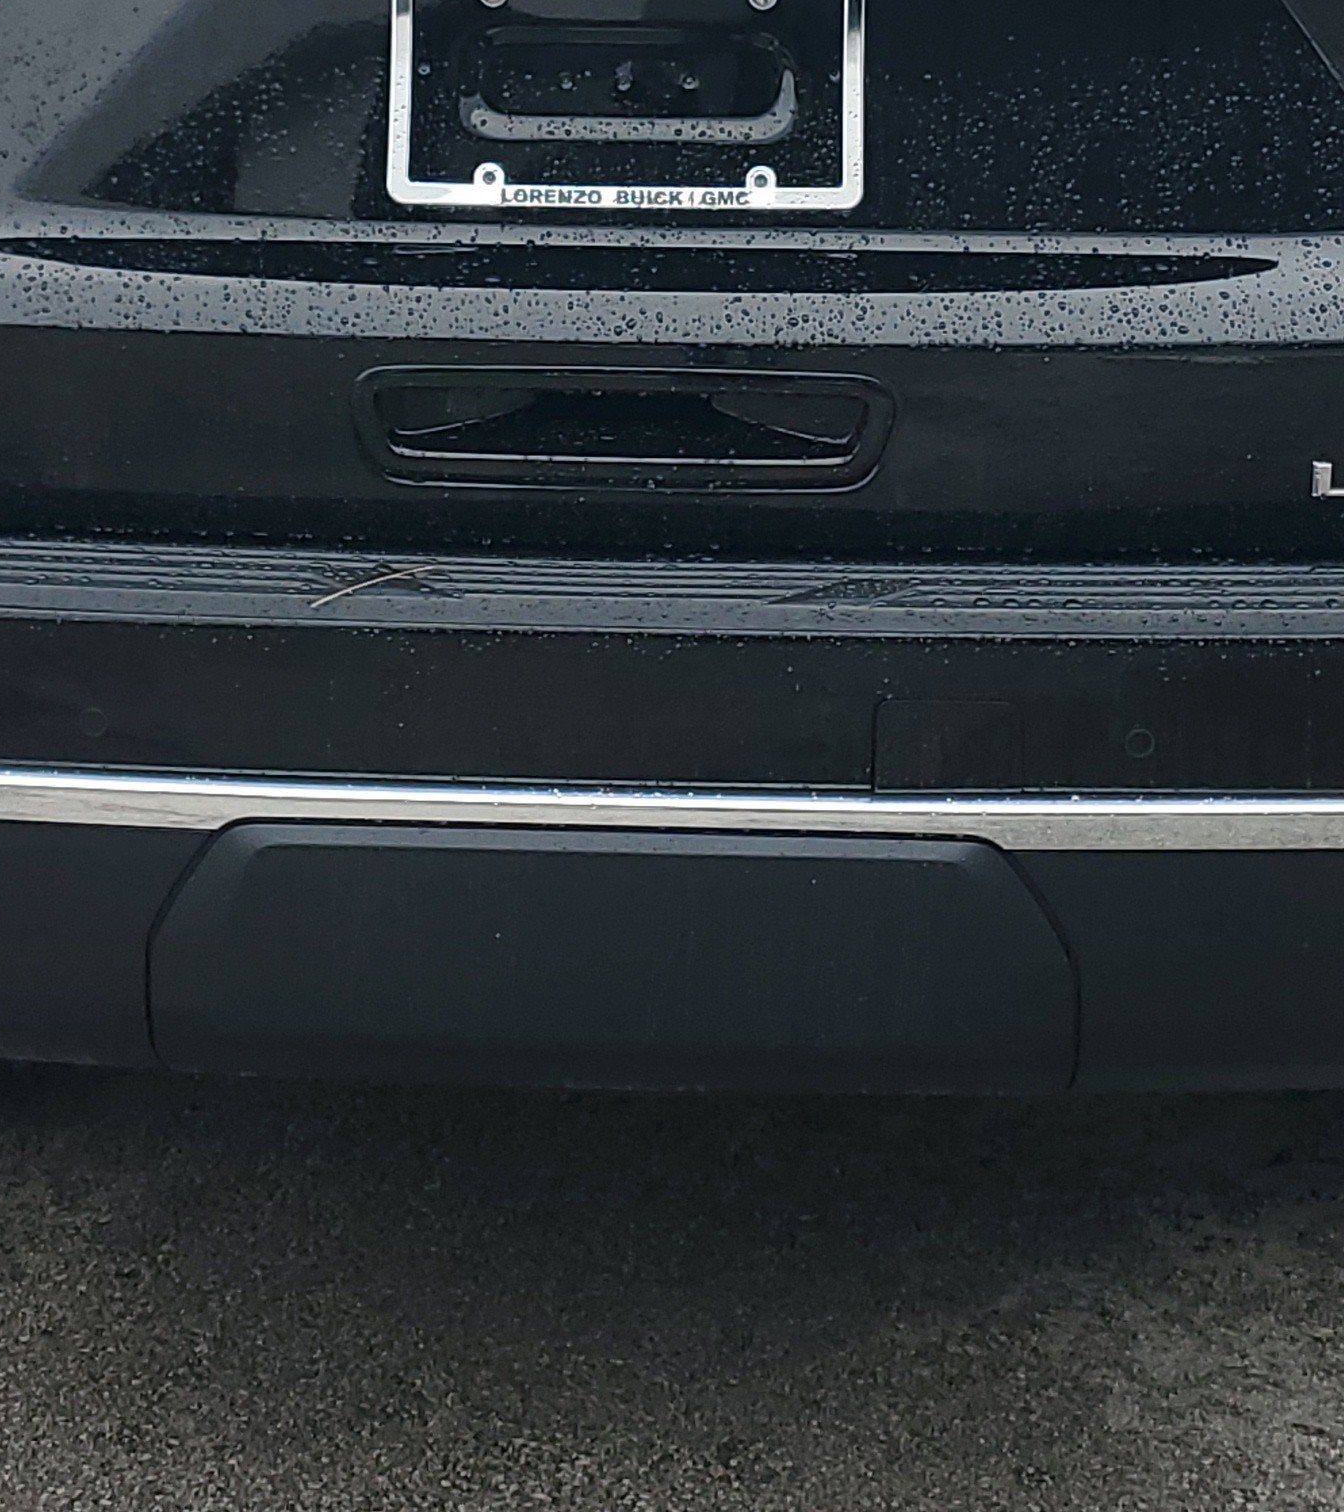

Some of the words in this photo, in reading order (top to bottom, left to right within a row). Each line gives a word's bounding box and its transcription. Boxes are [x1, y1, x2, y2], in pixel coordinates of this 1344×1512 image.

[500, 189, 602, 205] LORENZO
[613, 189, 683, 206] BUICK
[699, 190, 752, 206] GMC
